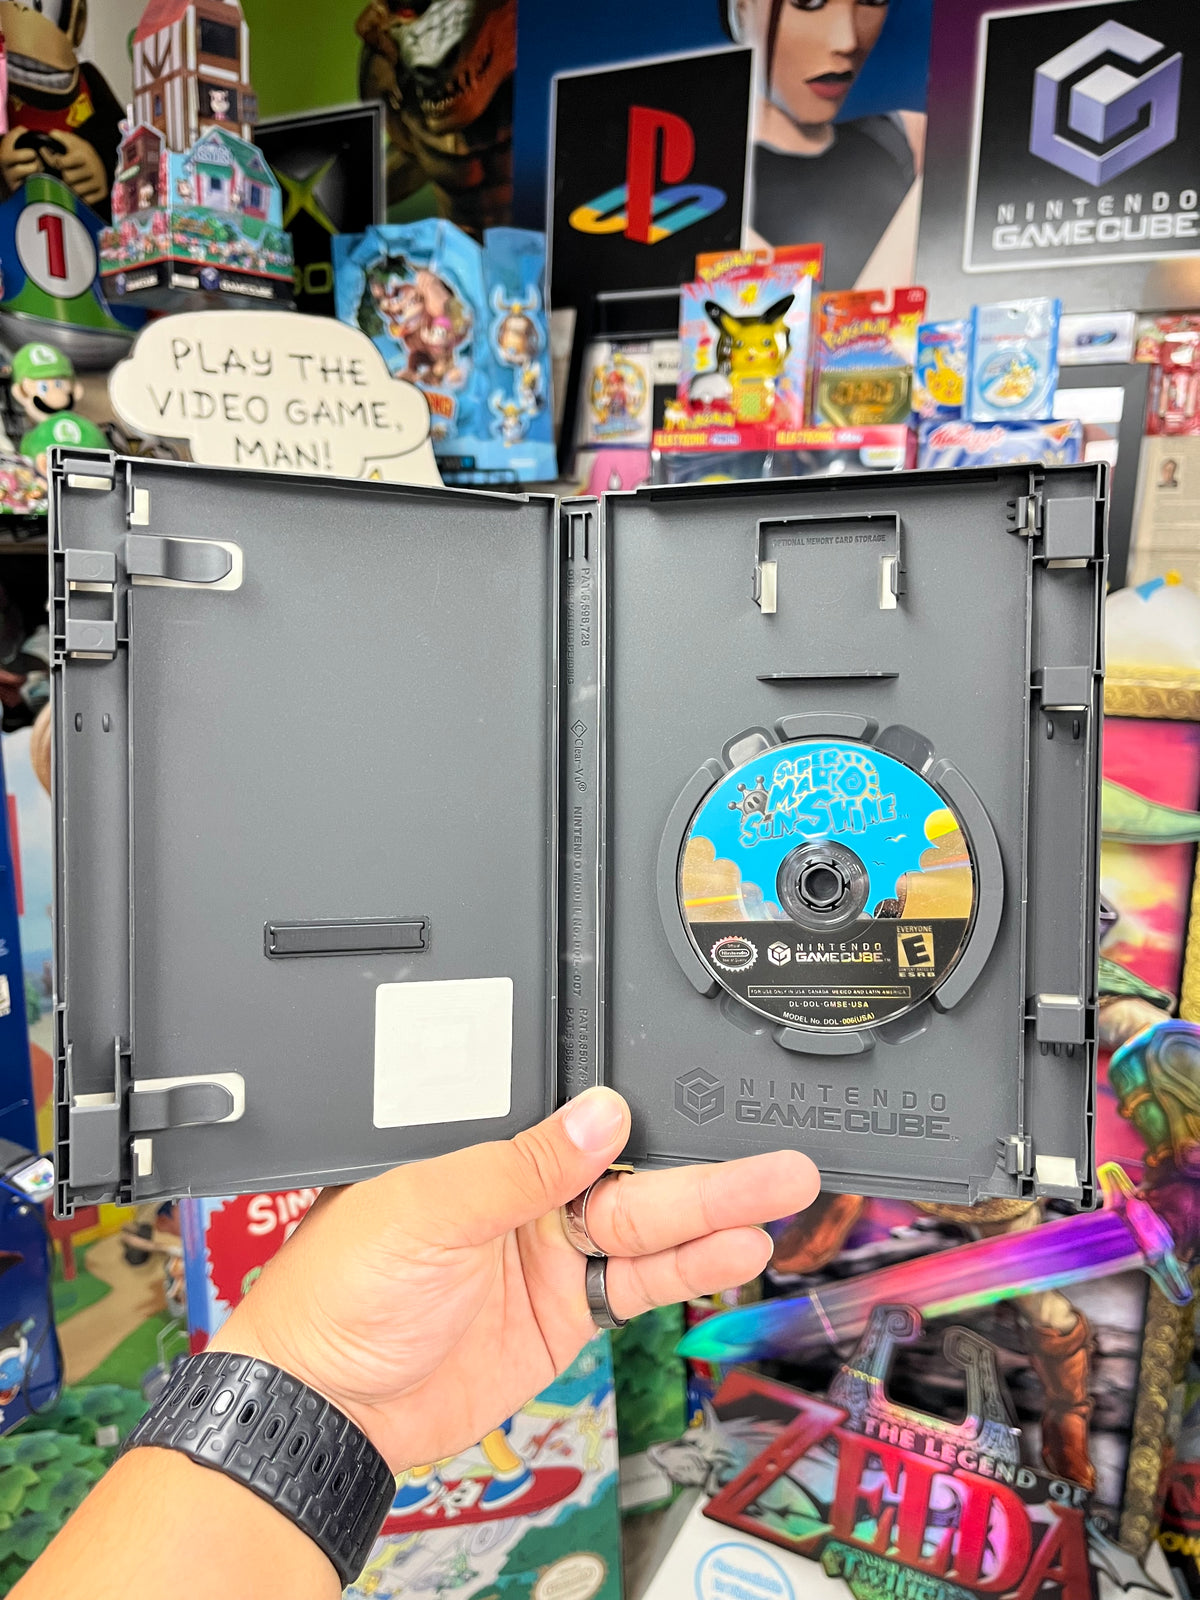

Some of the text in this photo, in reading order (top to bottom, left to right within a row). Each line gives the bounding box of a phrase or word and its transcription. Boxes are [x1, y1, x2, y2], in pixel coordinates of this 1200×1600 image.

[997, 189, 1197, 224] NINTENDO
[37, 213, 68, 279] 1
[992, 211, 1199, 250] GAMECUBE
[170, 336, 367, 386] PLAY THE
[147, 384, 268, 425] VIDEO
[234, 433, 334, 471] MAN!
[806, 537, 834, 545] MEMORY
[835, 536, 853, 544] CARD
[854, 534, 886, 543] STORAGE
[766, 748, 877, 812] SUPER MARIO
[573, 806, 583, 869] NINTENDO
[796, 943, 882, 951] NINTENDO
[796, 952, 883, 963] GAMECUBE
[783, 1011, 808, 1023] MODEL
[739, 1078, 947, 1113] NINTENDO
[735, 1100, 951, 1141] GAMECUBE
[864, 1418, 916, 1451] THE
[923, 1431, 1037, 1489] LEGEND
